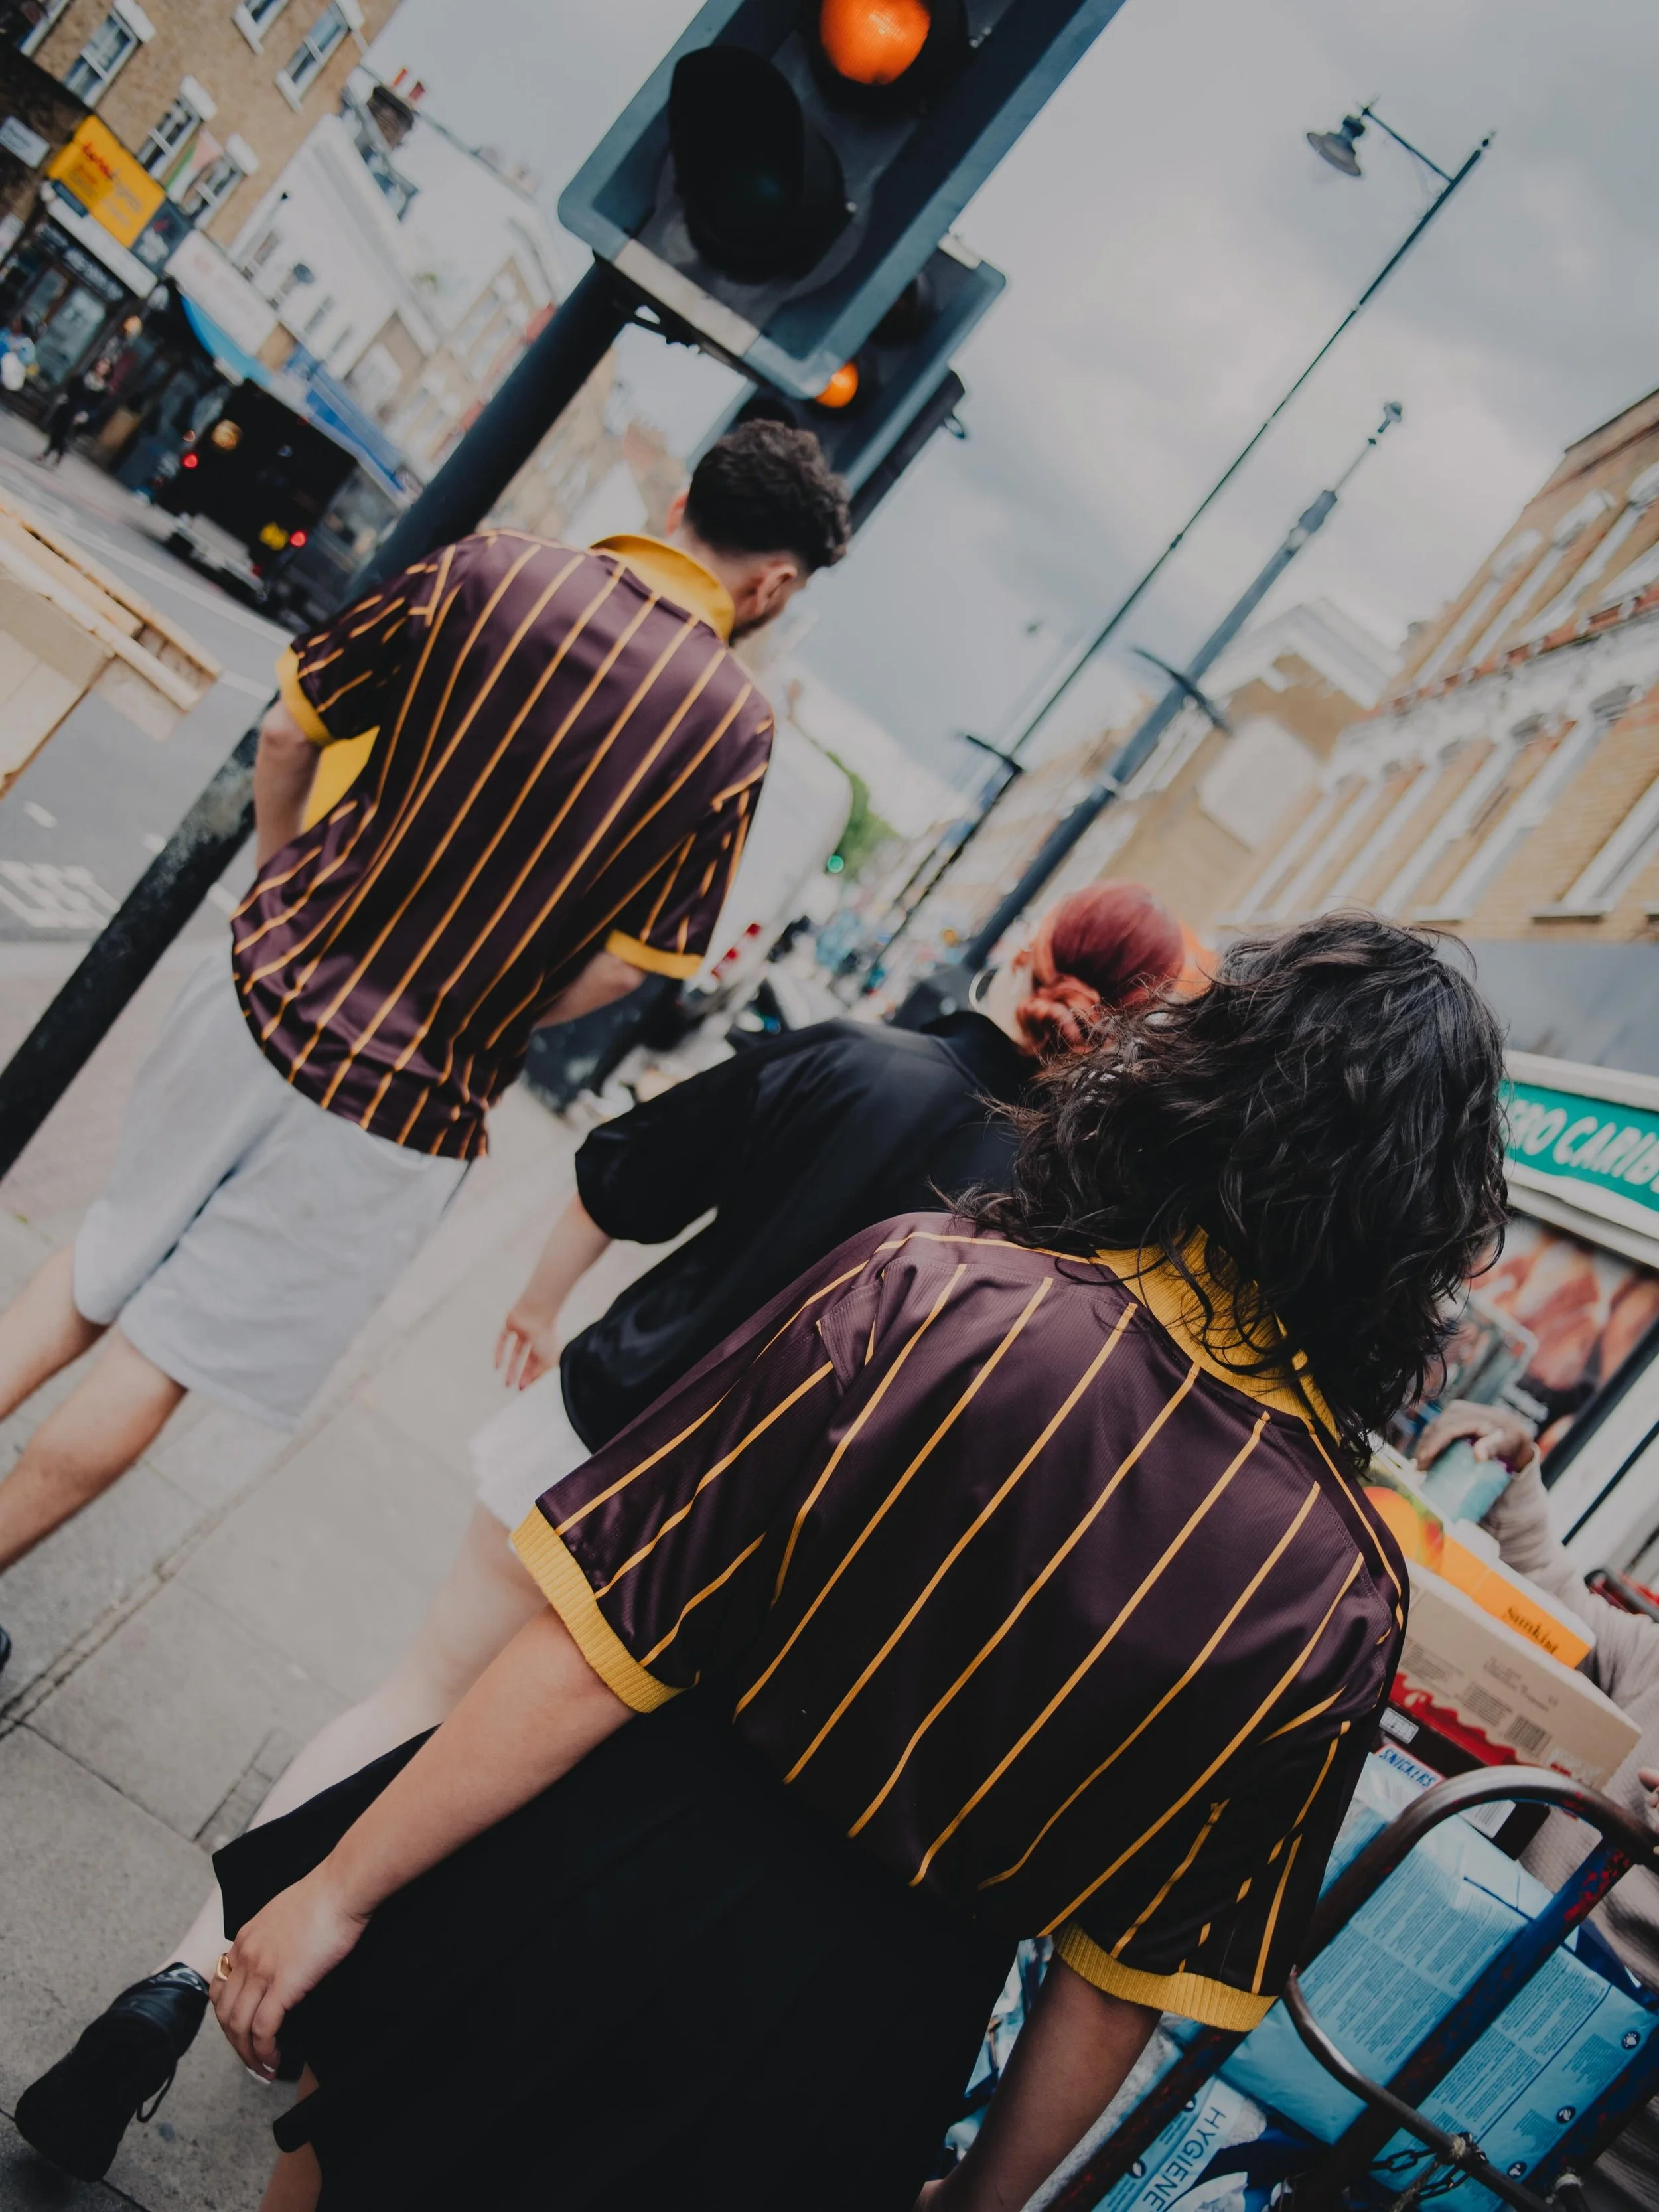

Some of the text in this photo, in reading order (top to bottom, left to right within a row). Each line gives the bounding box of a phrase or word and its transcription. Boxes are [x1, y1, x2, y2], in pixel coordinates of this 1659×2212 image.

[1552, 1116, 1659, 1194] CARIB
[1379, 1749, 1436, 1787] SNICKERS
[1143, 2106, 1226, 2211] HYGIENE
